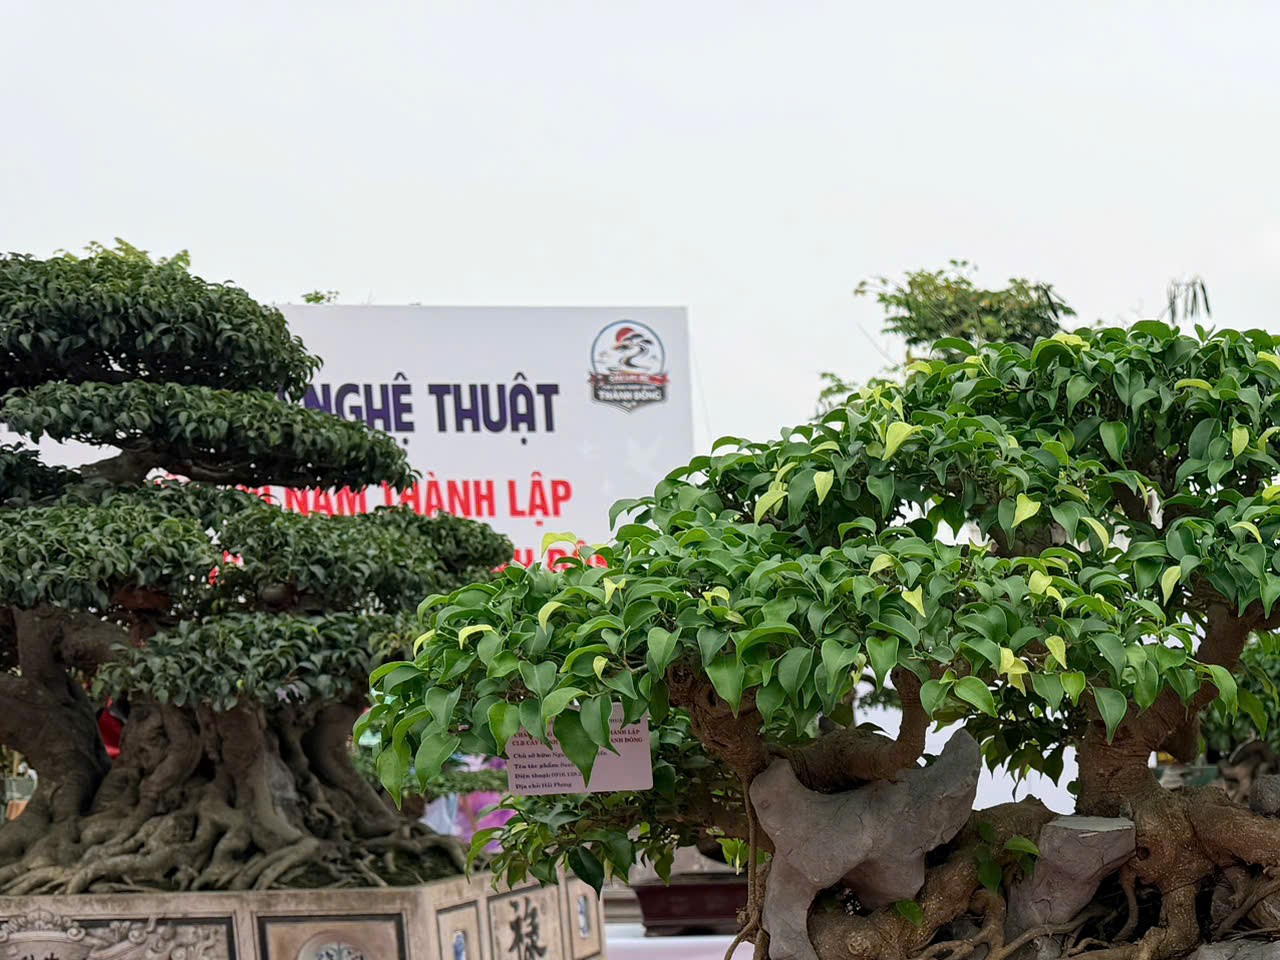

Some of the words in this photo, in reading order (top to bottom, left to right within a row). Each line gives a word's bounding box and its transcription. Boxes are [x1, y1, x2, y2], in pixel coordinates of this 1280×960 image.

[303, 372, 415, 446] NGHỆ
[428, 371, 560, 446] THUẬT
[507, 470, 573, 527] LẬP
